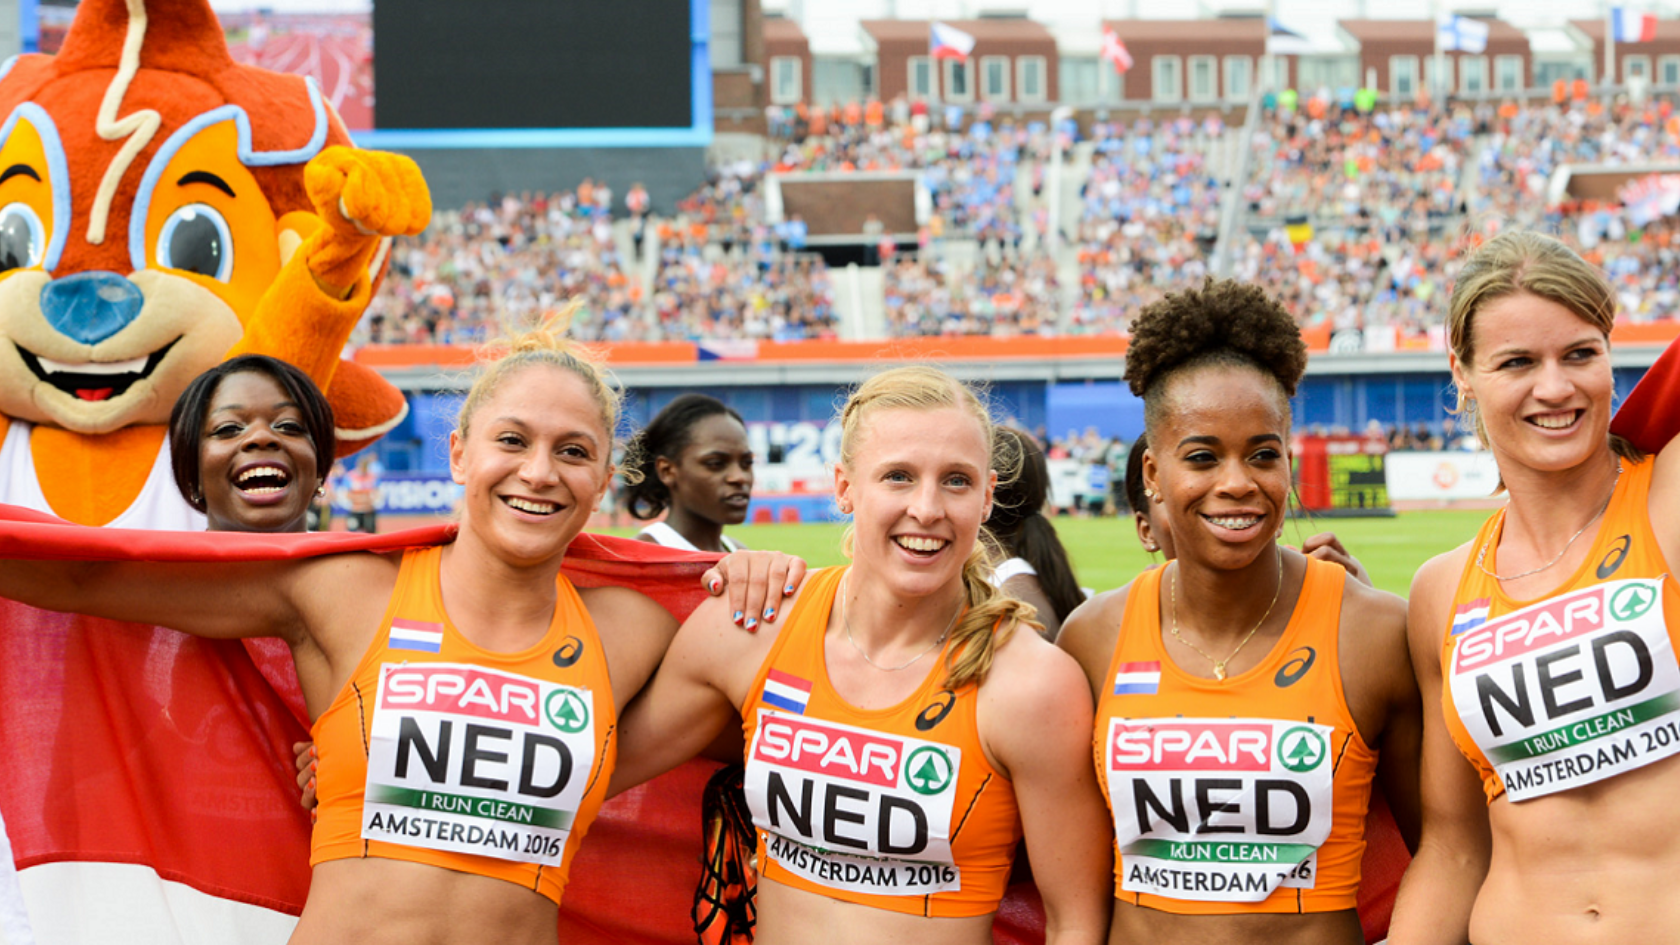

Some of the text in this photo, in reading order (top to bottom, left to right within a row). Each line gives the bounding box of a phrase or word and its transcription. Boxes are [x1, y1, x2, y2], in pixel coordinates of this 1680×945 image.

[1459, 596, 1600, 667] SPAR
[386, 672, 537, 719] SPAR
[1475, 629, 1654, 737] NED
[394, 716, 573, 798] NED
[759, 722, 898, 780] SPAR
[1115, 730, 1268, 764] SPAR
[1505, 721, 1680, 792] AMSTERDAM 201
[1524, 709, 1635, 755] I RUN CLEAN
[421, 793, 533, 823] I RUN CLEAN
[766, 771, 929, 855] NED
[1132, 778, 1311, 836] NED
[368, 811, 562, 857] AMSTERDAM 2016
[1216, 844, 1278, 861] CLEAN
[770, 836, 898, 887] AMSTERDAM
[905, 866, 956, 887] 2016
[1129, 864, 1269, 892] AMSTERDAM
